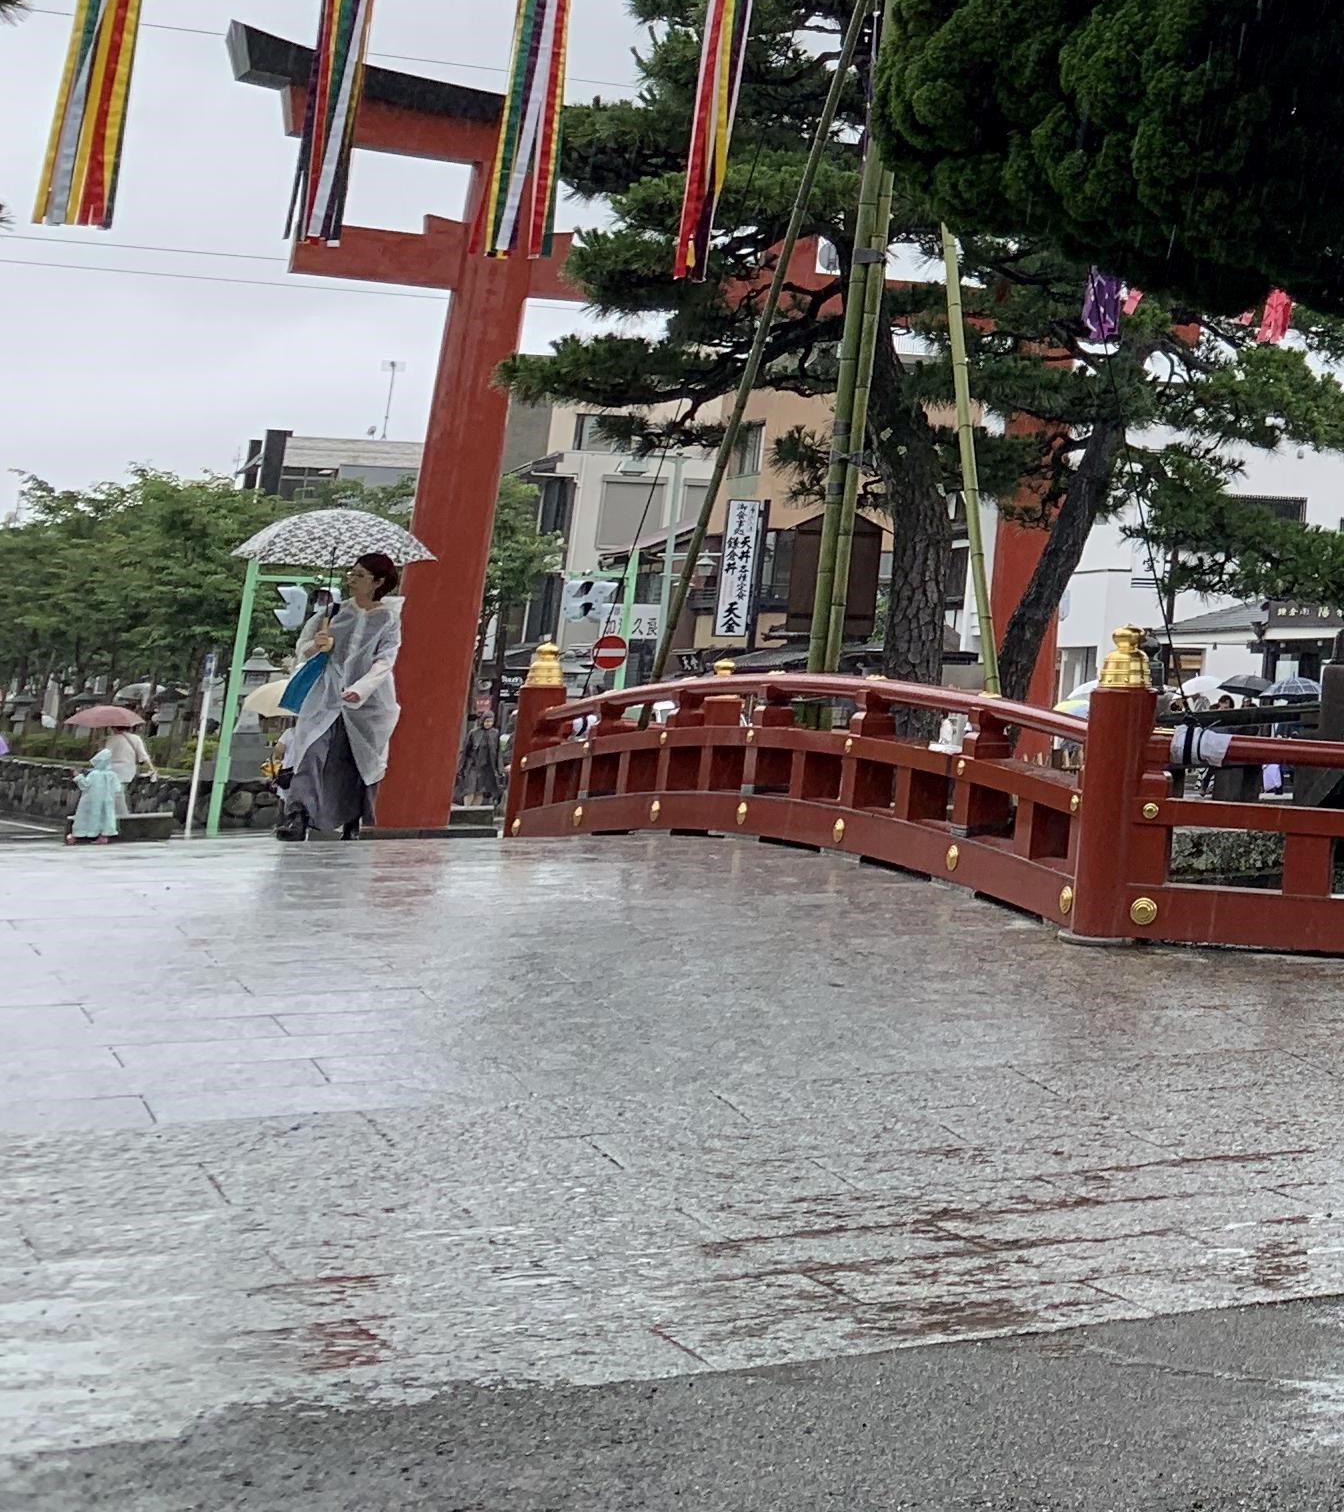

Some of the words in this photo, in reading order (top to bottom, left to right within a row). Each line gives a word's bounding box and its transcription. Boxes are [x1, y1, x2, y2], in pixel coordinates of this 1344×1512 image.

[603, 617, 659, 636] 加久良
[720, 601, 742, 633] 天金
